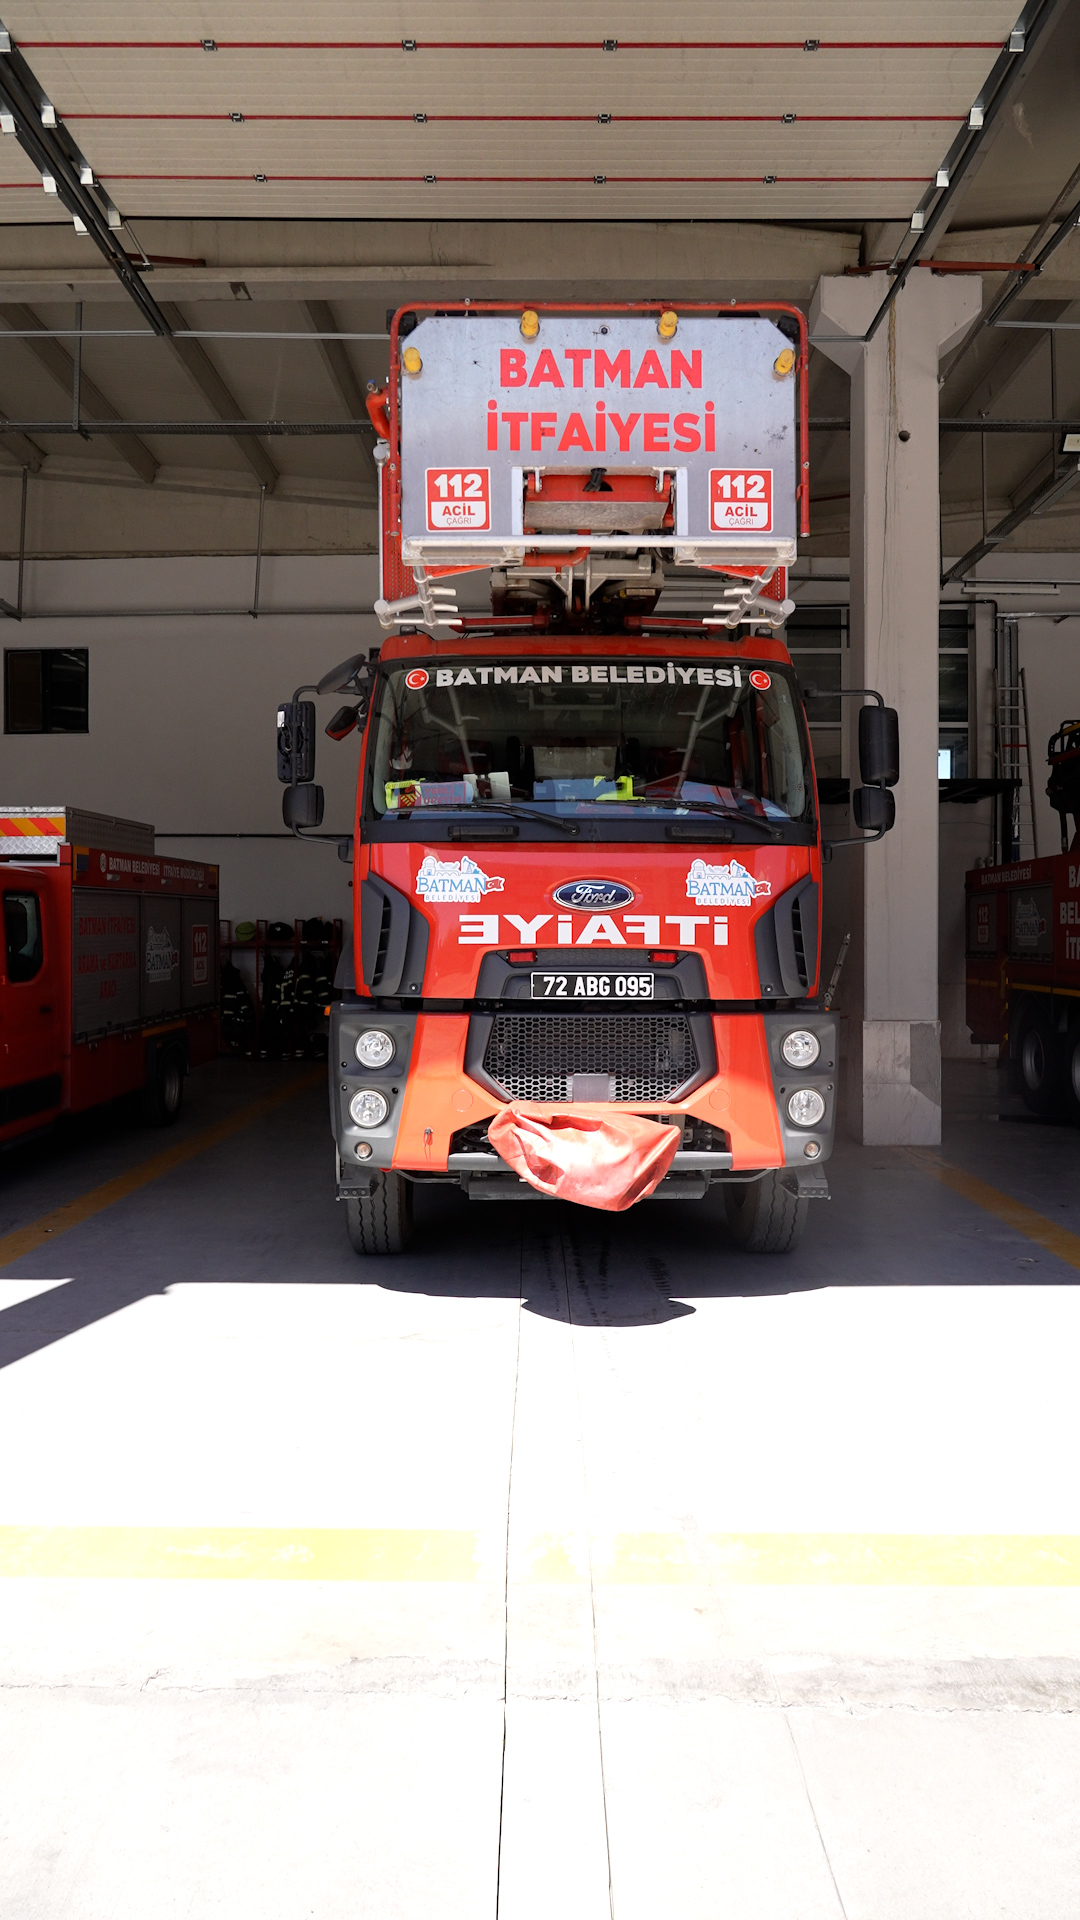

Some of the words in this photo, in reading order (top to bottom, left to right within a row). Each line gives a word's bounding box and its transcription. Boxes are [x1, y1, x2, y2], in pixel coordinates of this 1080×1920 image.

[500, 349, 702, 389] BATMAN
[487, 399, 716, 452] İTFAİYESİ
[433, 473, 483, 498] 112
[717, 474, 766, 499] 112
[442, 503, 476, 516] ACİL
[724, 504, 758, 517] ACİL
[446, 516, 472, 526] ÇAĞRI
[728, 517, 754, 527] ÇAĞRI
[436, 665, 563, 688] BATMAN
[571, 662, 742, 688] BELEDİYESİ
[108, 857, 131, 873] BATMAN
[981, 872, 1002, 886] BATMAN
[1002, 864, 1032, 883] BELEDİYESİ
[417, 877, 487, 893] BATMAN
[571, 884, 617, 904] Ford
[688, 880, 756, 897] BATMAN
[697, 897, 750, 905] BELEDİYESİ
[978, 905, 989, 923] 112
[79, 916, 106, 937] BATMAN
[193, 931, 207, 953] 112
[78, 954, 99, 975] ARAMA
[146, 951, 174, 971] BATMAN
[543, 976, 568, 996] 72
[573, 976, 611, 996] ABG
[615, 976, 651, 997] 095
